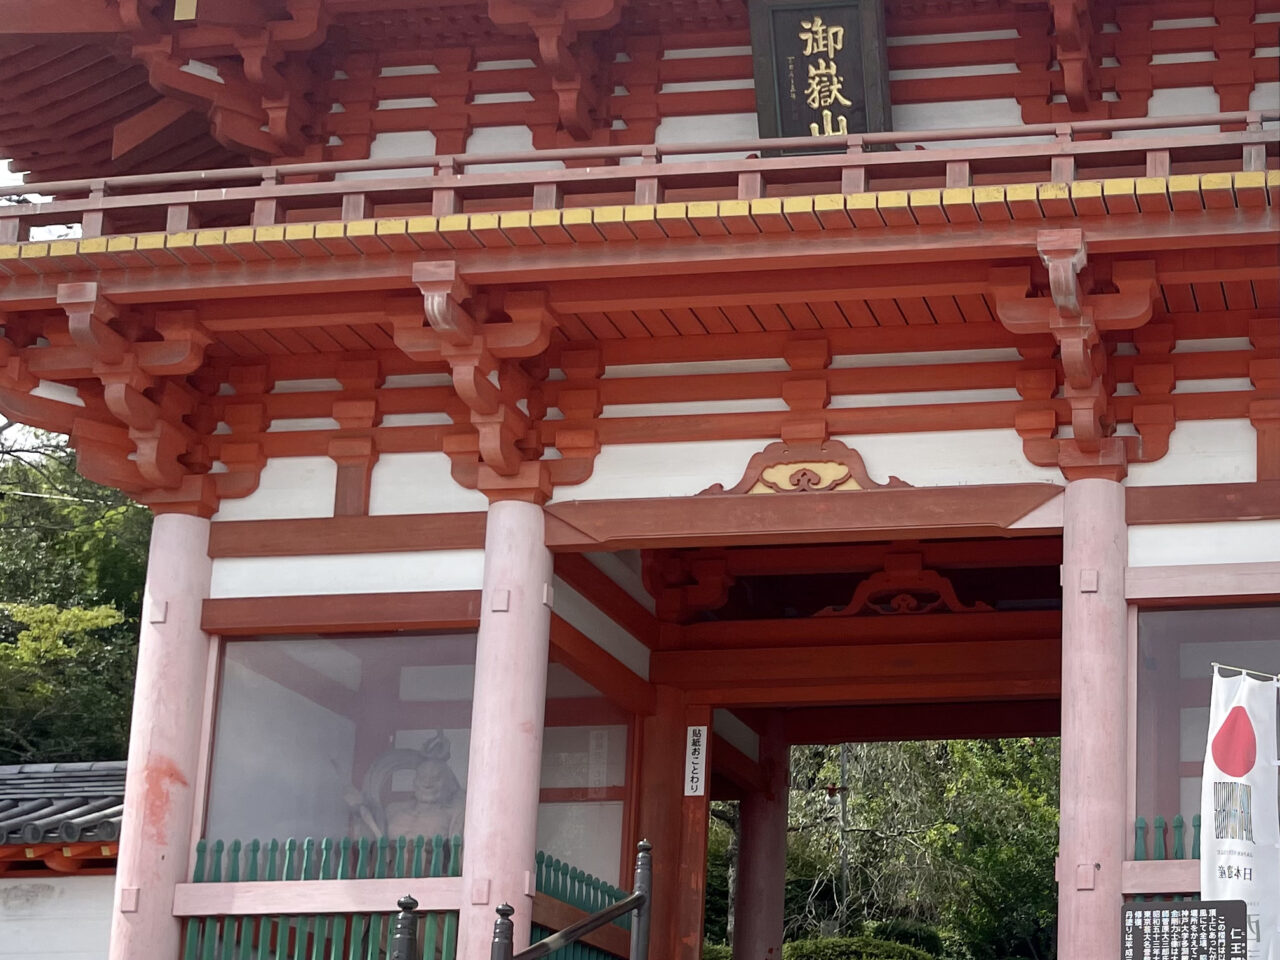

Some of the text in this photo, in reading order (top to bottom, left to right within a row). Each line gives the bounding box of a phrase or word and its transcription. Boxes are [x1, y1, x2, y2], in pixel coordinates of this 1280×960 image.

[798, 15, 852, 137] 御嶽山
[689, 728, 702, 793] 貼紙おことわり
